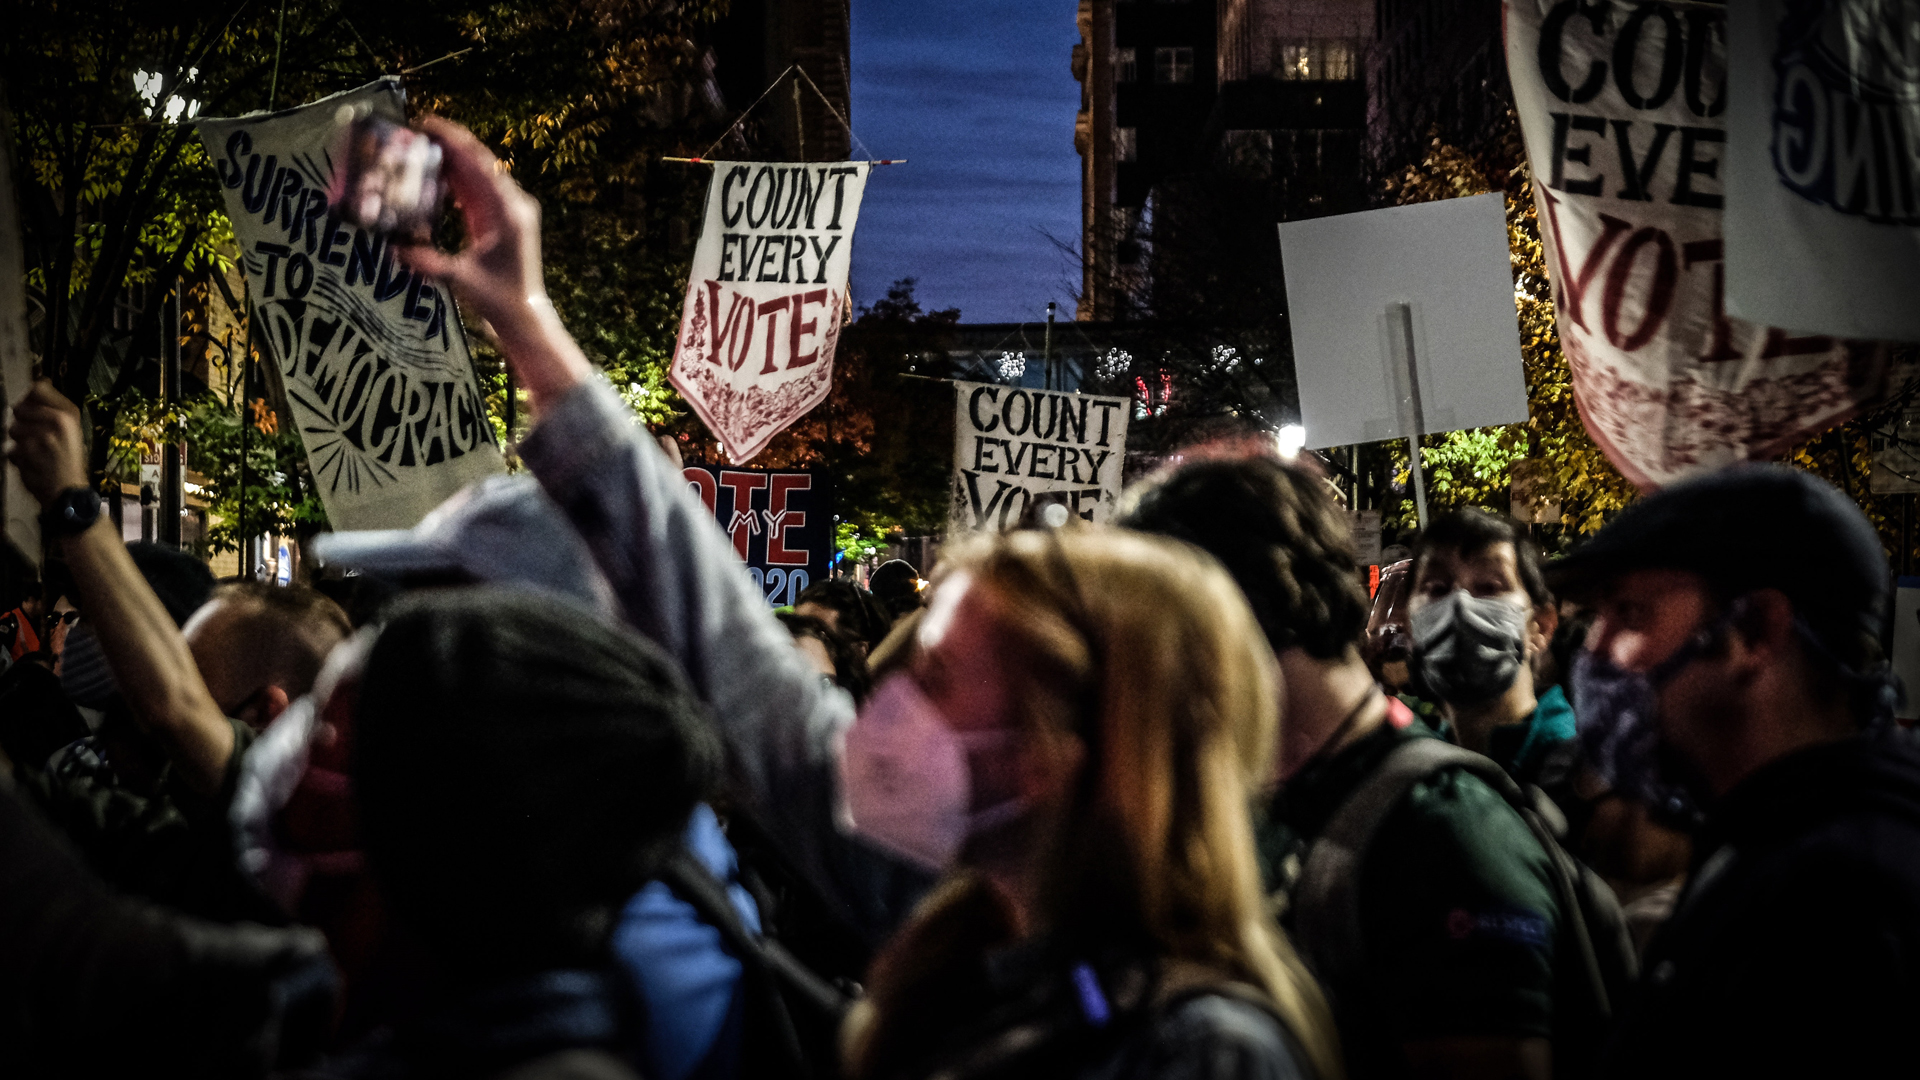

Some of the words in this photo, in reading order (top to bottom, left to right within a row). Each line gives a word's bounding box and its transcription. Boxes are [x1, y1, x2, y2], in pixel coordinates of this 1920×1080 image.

[1538, 0, 1726, 117] COU
[1549, 112, 1725, 209] EVE
[722, 165, 858, 230] COUNT
[255, 240, 314, 298] TO
[716, 233, 842, 284] EVERY
[704, 279, 828, 375] VOTE
[969, 386, 1121, 447] COUNT
[972, 435, 1110, 485] EVERY
